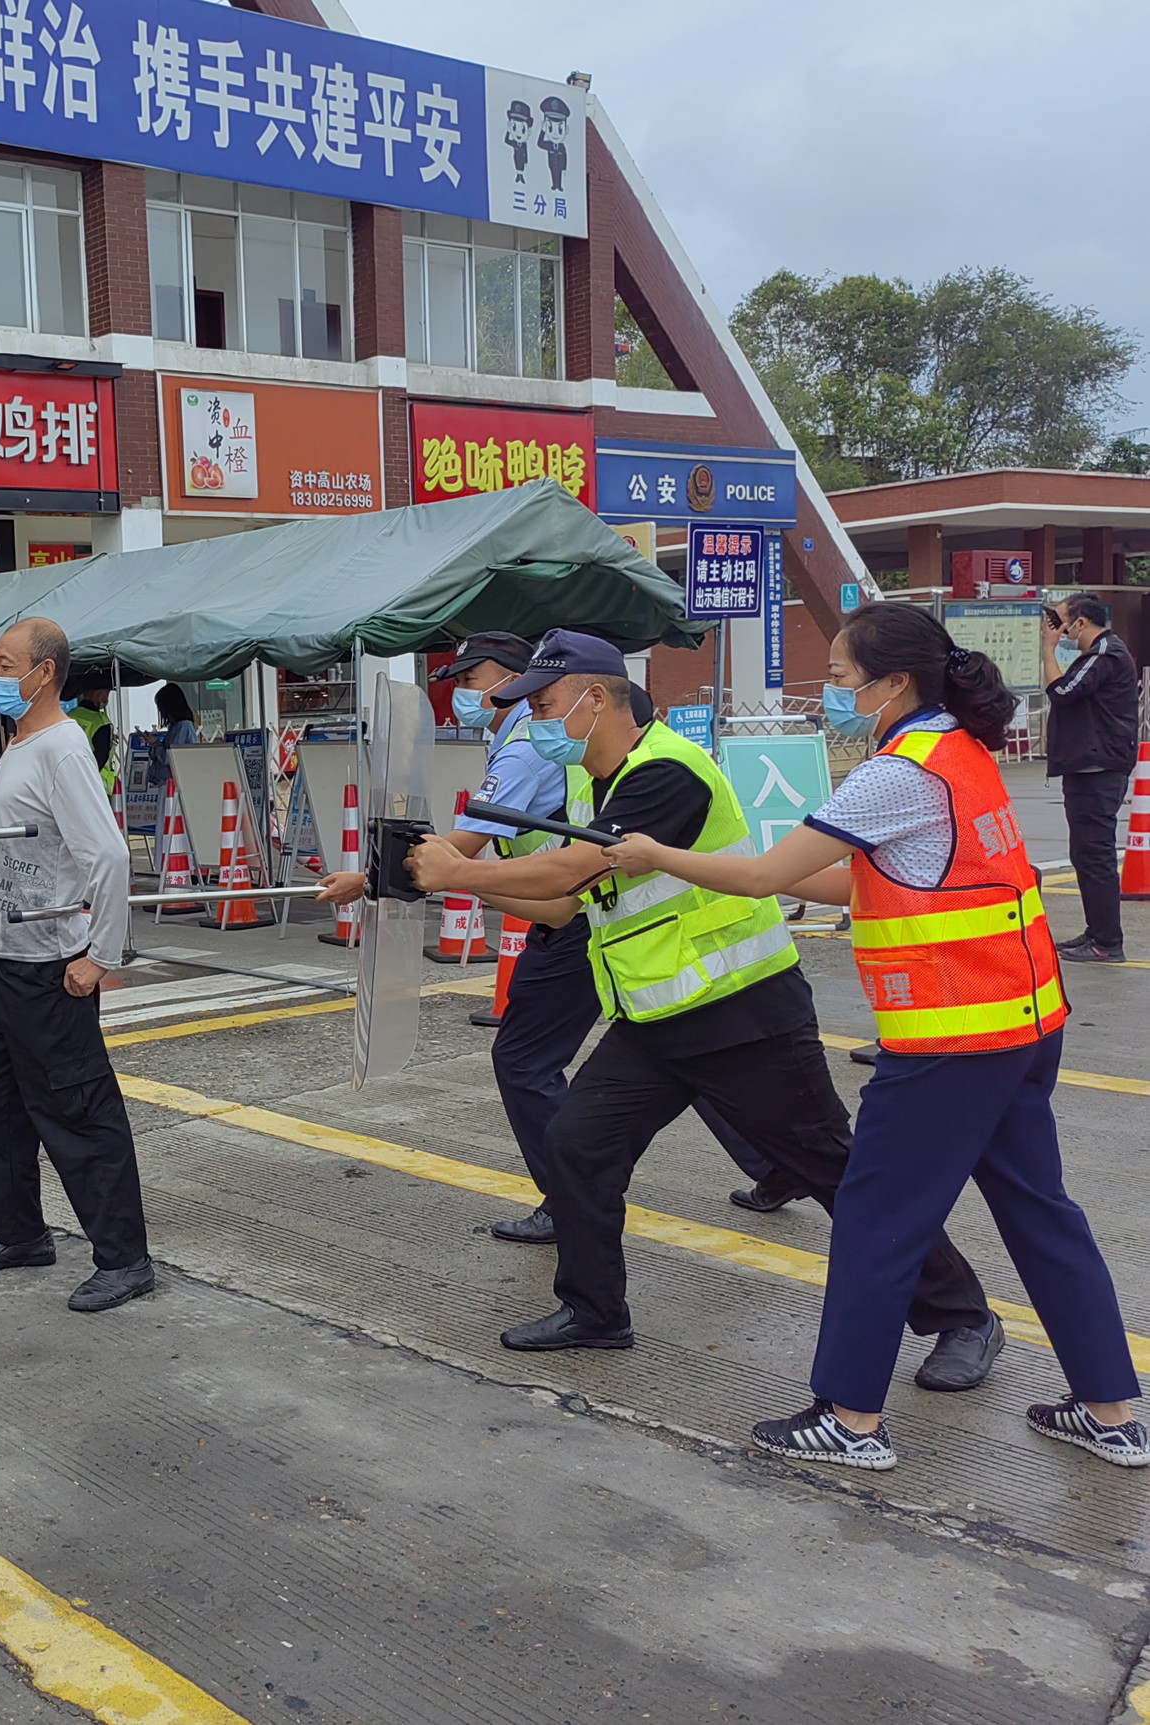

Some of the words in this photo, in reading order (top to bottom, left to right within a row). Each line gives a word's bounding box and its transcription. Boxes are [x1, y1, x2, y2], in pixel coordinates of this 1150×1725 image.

[133, 20, 462, 188] 携手共建平安
[512, 190, 567, 220] 三分局
[207, 396, 224, 459] 资中
[225, 417, 253, 474] 血橙
[422, 434, 586, 498] 绝味鸭脖
[290, 470, 371, 491] 资中高山农场
[628, 474, 676, 504] 公安
[290, 492, 373, 508] 18308256996
[726, 485, 776, 501] POLICE
[702, 534, 752, 555] 温馨提示
[696, 559, 756, 583] 请主动扫码
[695, 586, 755, 608] 出示通信行程卡
[3, 855, 40, 876] SECRET
